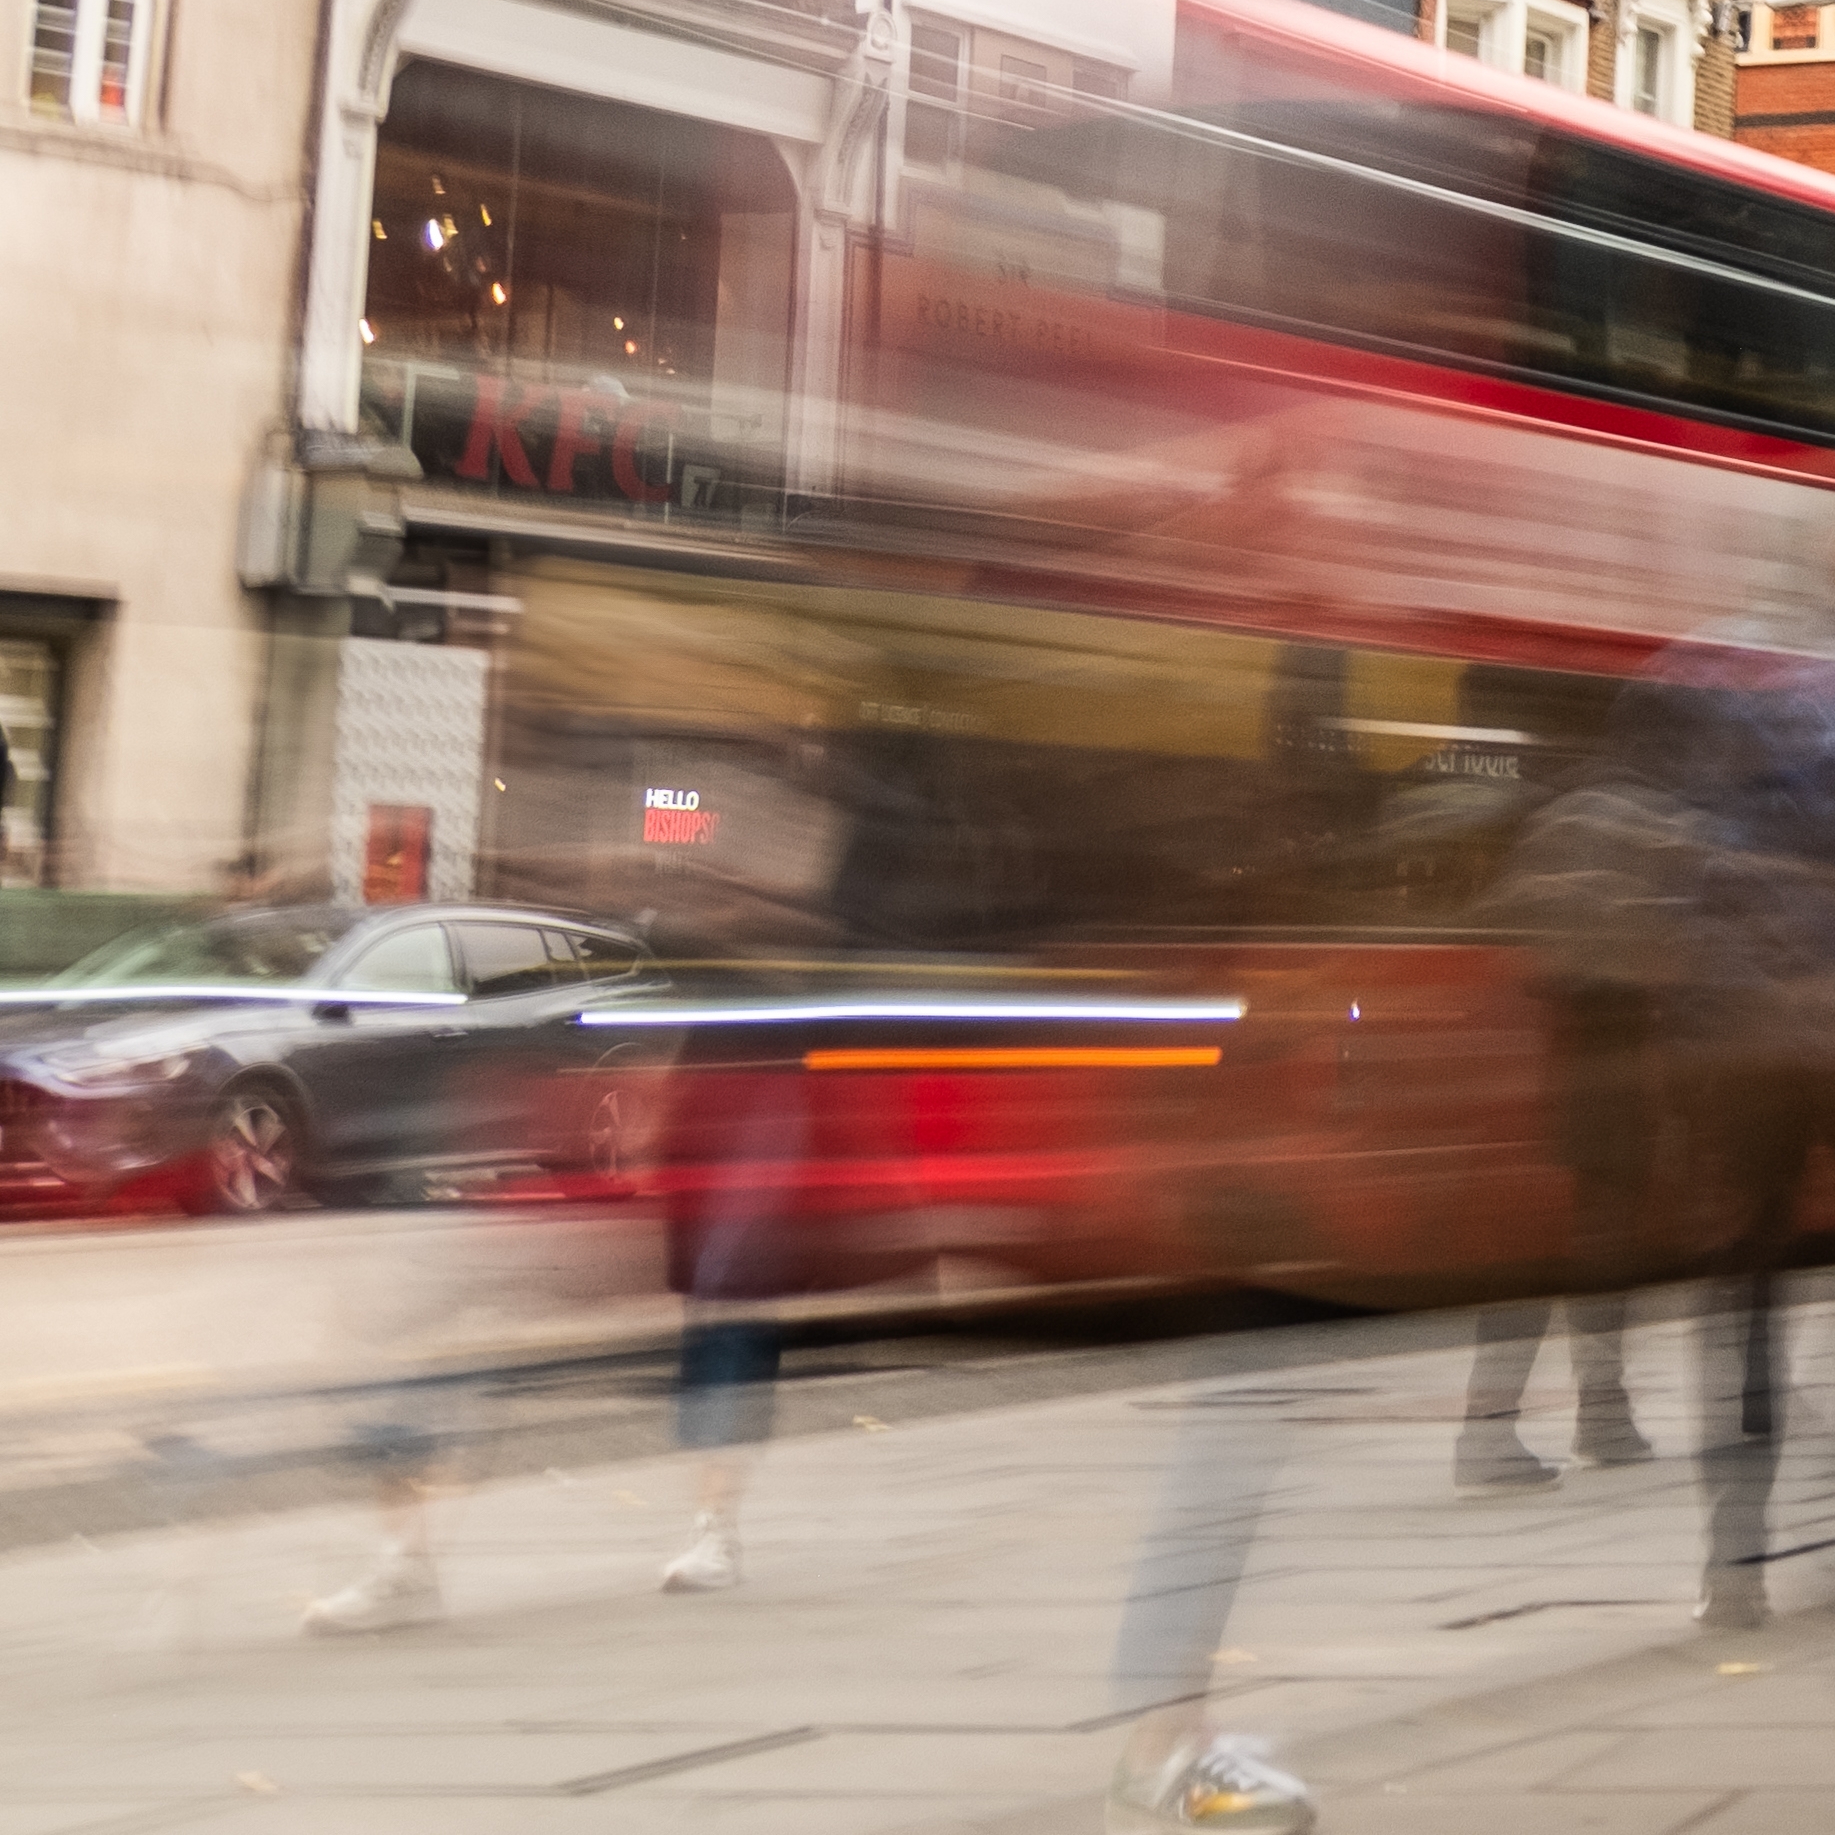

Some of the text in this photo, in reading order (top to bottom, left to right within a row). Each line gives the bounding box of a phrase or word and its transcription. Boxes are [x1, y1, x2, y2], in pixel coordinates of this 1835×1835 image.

[916, 293, 1023, 344] ROBERT
[454, 375, 682, 504] KFC
[645, 787, 700, 811] HELLO
